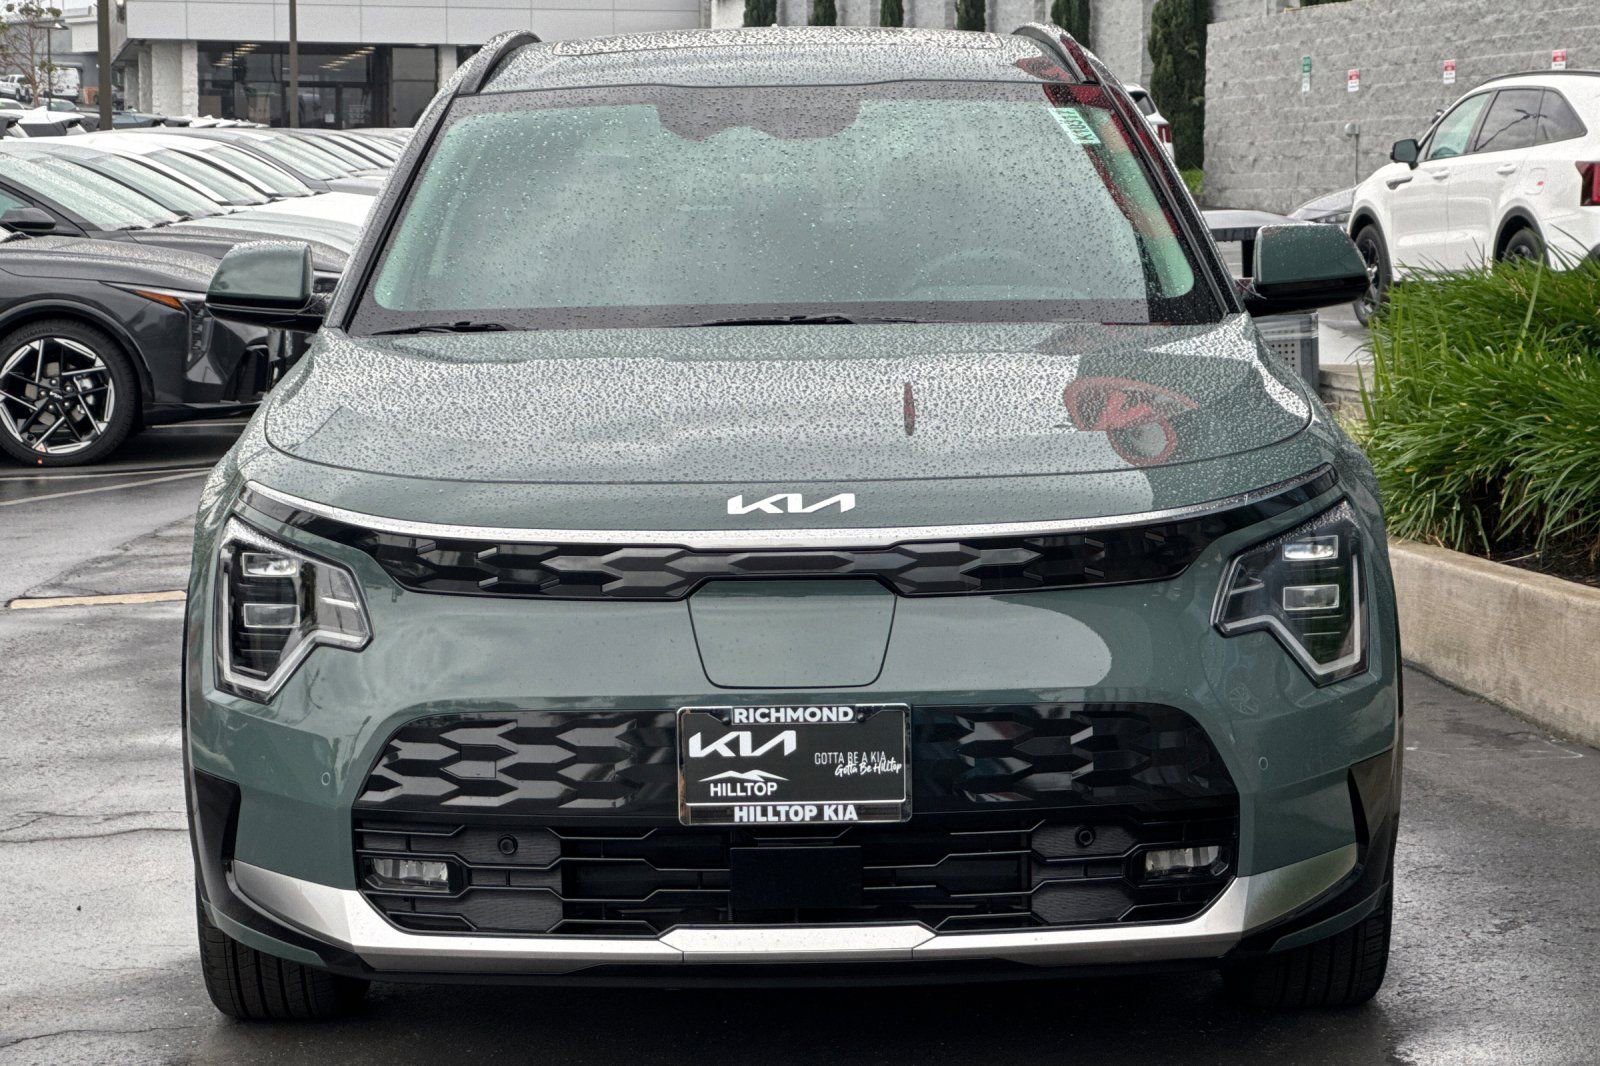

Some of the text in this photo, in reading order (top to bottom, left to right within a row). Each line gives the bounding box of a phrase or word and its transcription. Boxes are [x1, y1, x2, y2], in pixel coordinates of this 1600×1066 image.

[727, 493, 856, 515] KIA
[733, 707, 854, 723] RICHMOND
[688, 730, 797, 757] KIA
[814, 751, 886, 765] GOTTA BE A KIA
[834, 757, 902, 777] Gotta Be Hilltop
[710, 782, 778, 797] HILLTOP
[734, 804, 858, 822] HILLTOP KIA
